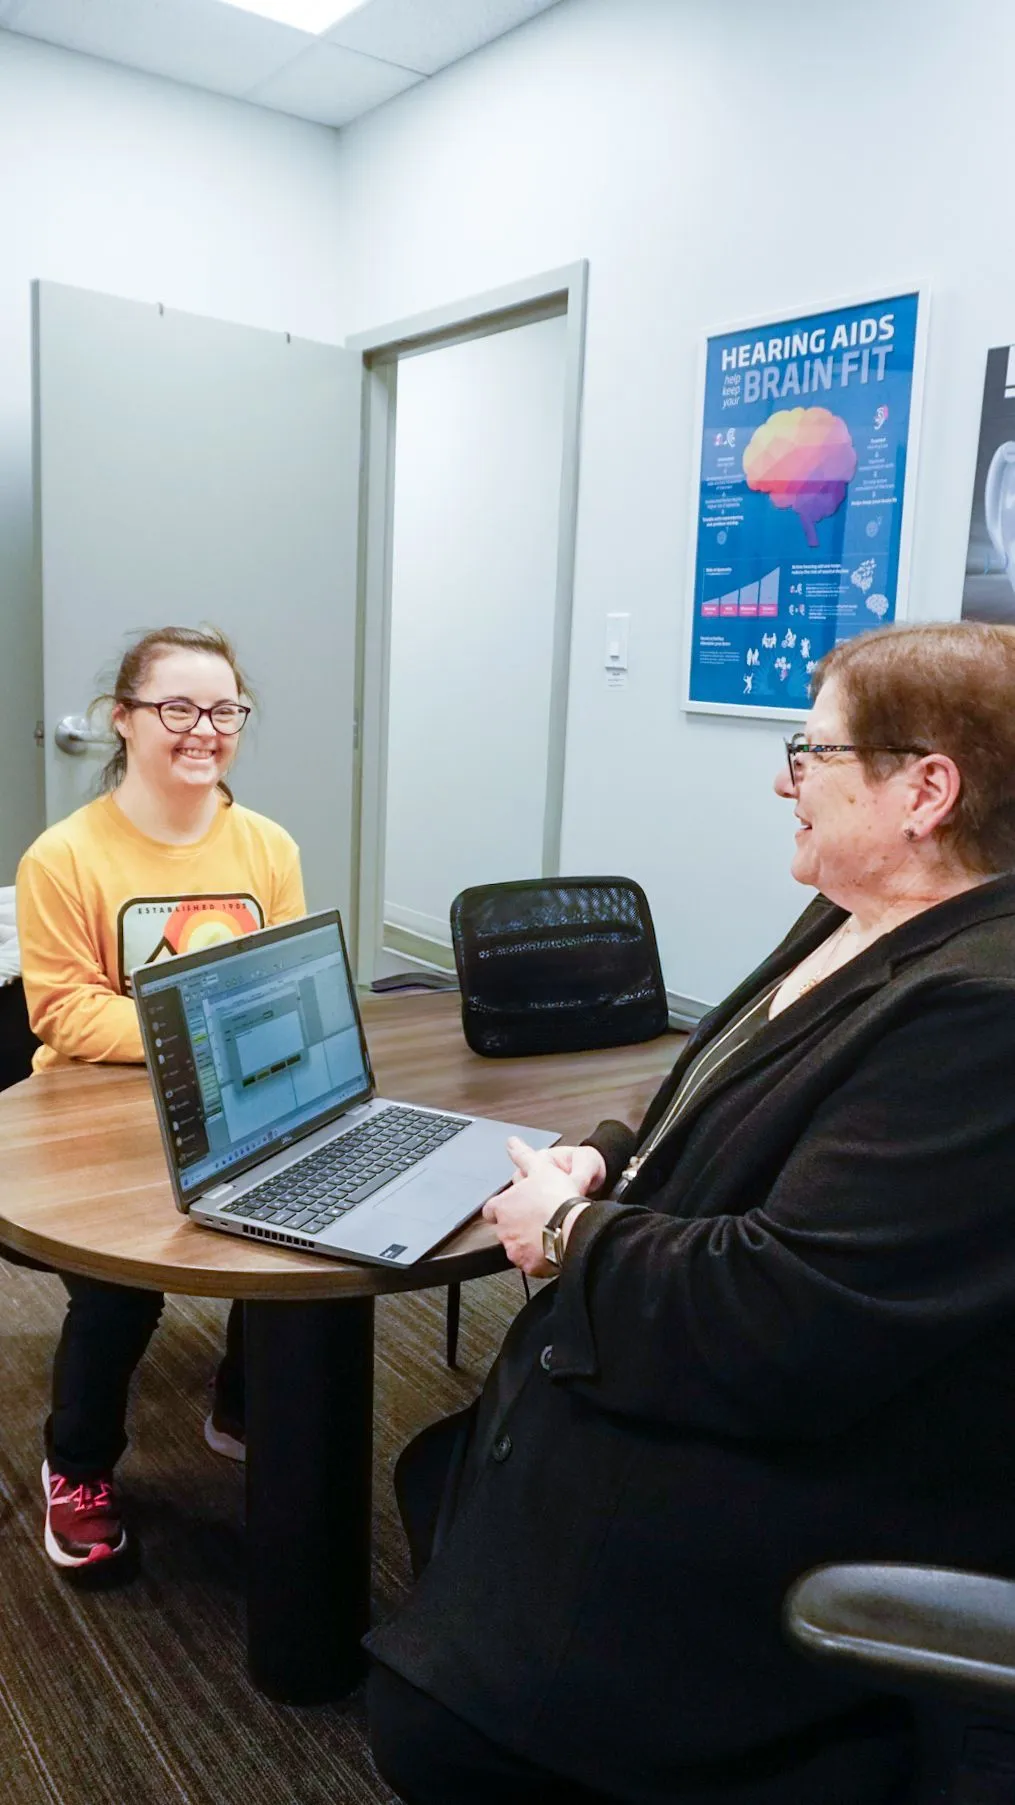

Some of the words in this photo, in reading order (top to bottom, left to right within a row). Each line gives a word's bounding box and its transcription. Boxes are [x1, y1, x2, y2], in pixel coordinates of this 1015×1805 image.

[722, 329, 825, 371] HEARING
[831, 314, 895, 350] AIDS
[724, 373, 741, 385] help
[744, 356, 834, 403] BRAIN
[840, 344, 893, 387] FIT
[722, 385, 740, 396] keep
[722, 396, 740, 409] your
[138, 904, 215, 914] ESTABLISHED
